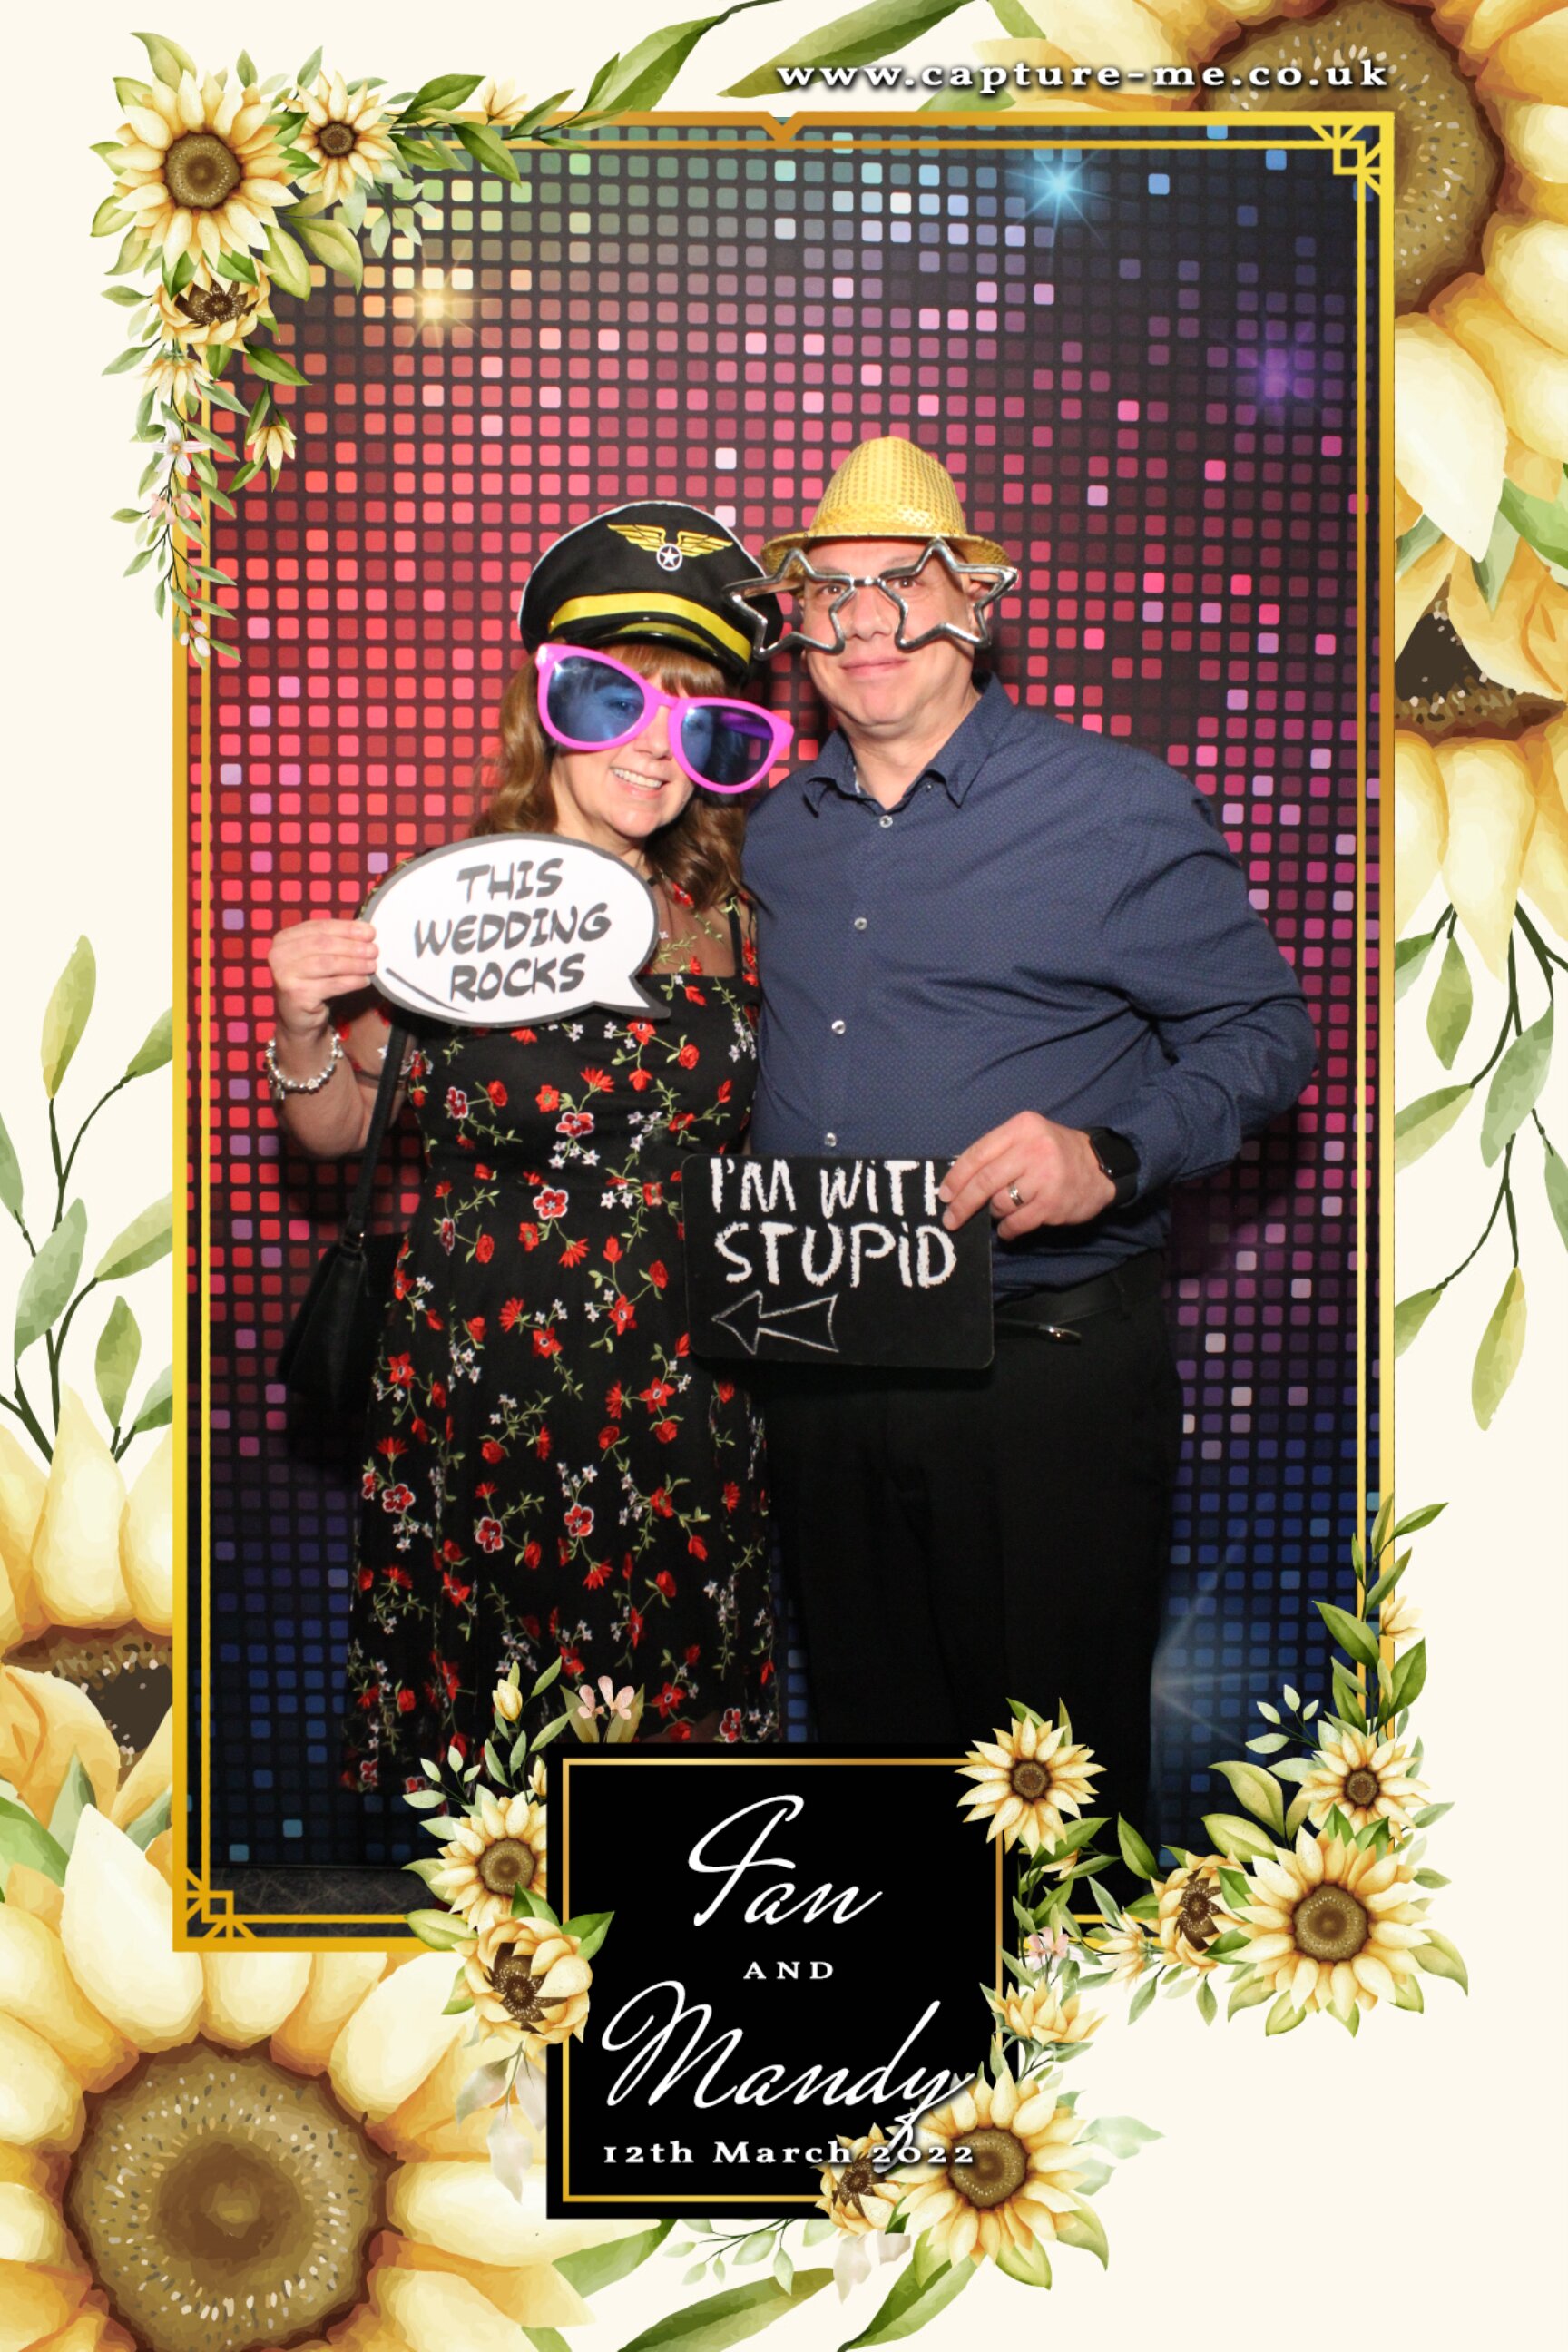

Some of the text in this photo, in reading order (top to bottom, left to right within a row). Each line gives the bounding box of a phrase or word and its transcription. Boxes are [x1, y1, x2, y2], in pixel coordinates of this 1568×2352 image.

[456, 858, 564, 903] THIS
[414, 902, 612, 958] WEDDING
[450, 952, 586, 1002] ROCKS
[710, 1157, 797, 1213] I'M
